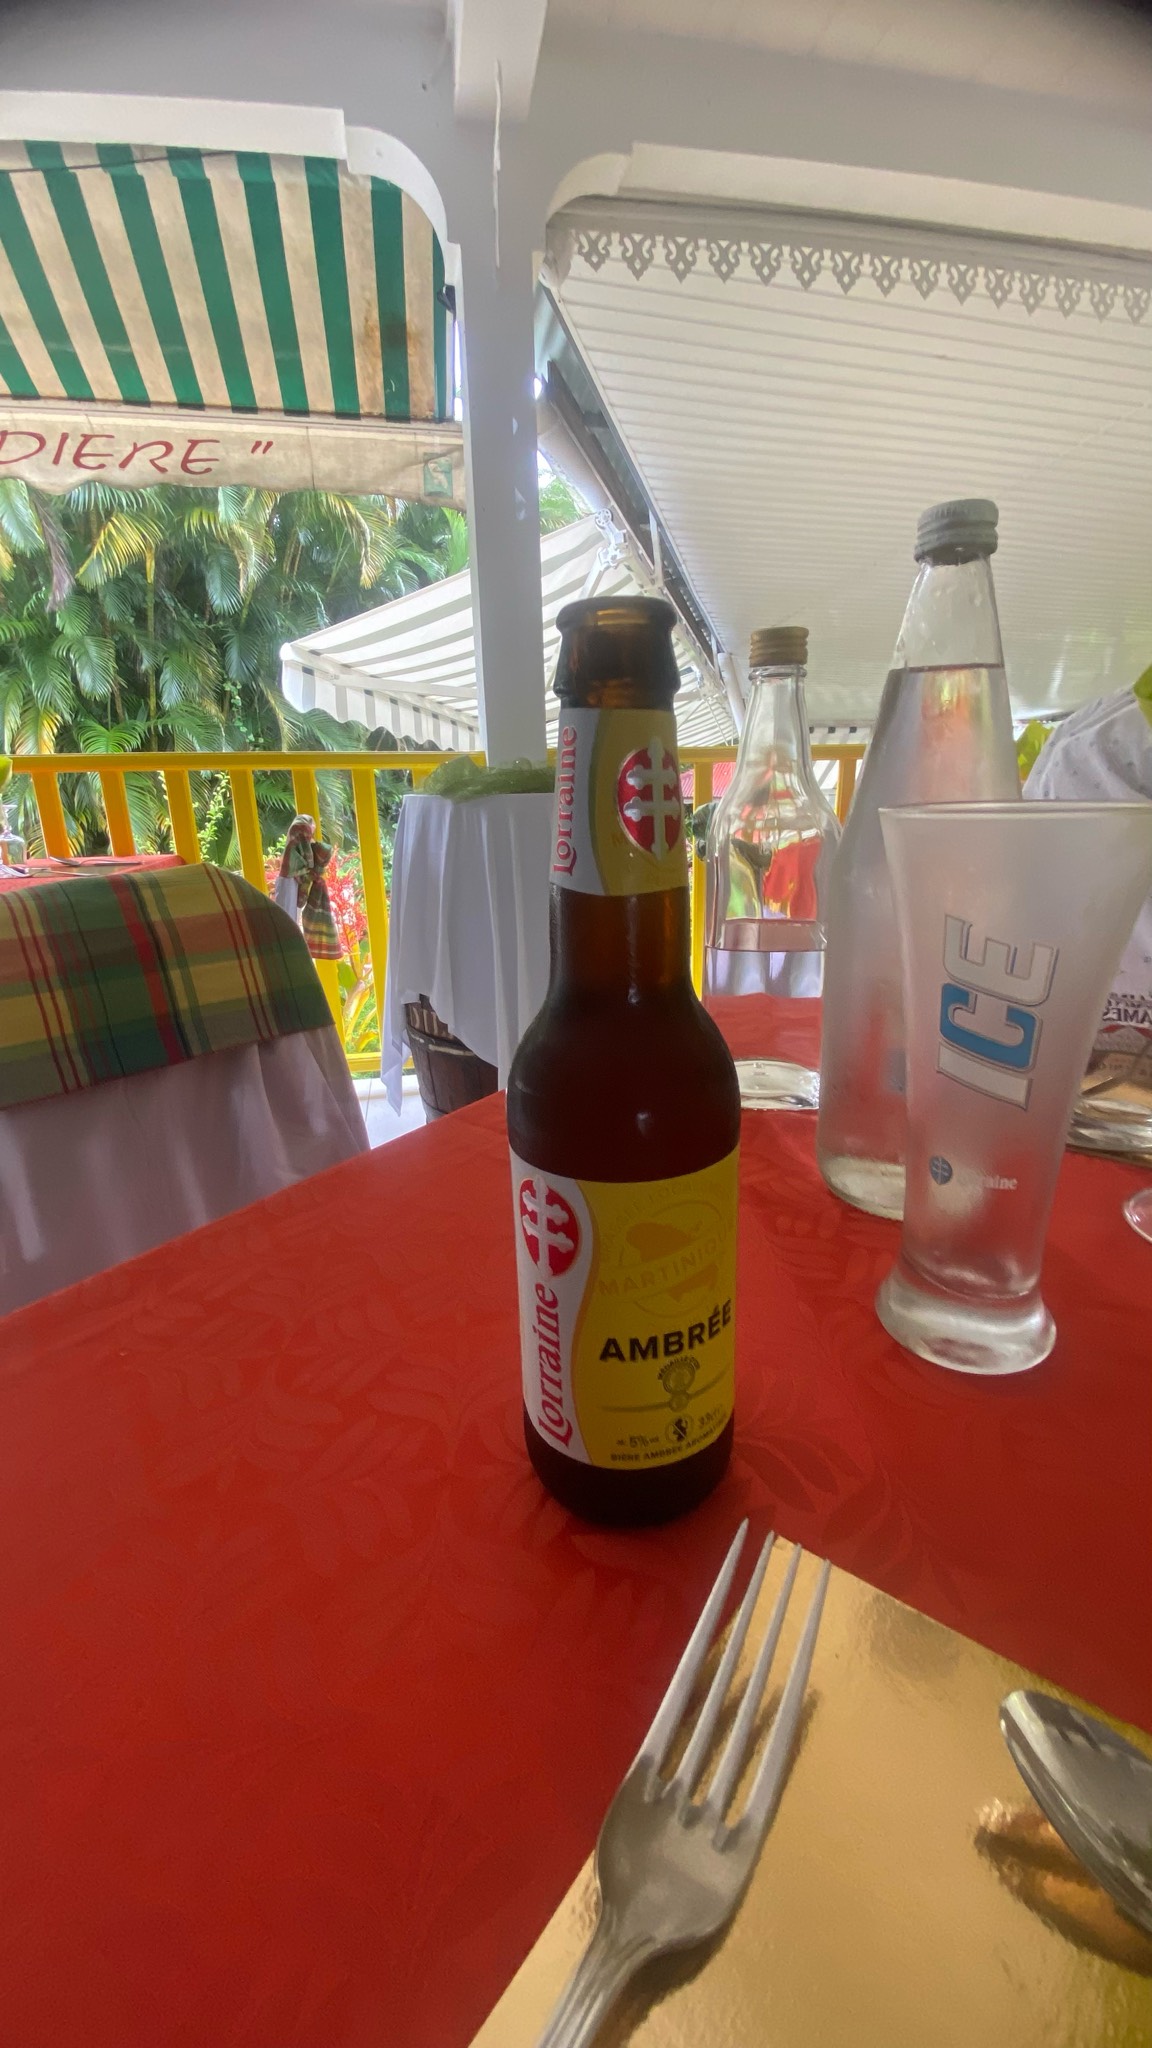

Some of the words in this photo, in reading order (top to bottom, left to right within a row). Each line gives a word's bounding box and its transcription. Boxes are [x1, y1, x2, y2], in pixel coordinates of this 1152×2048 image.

[553, 725, 578, 877] Lorraine
[936, 914, 1060, 1112] ICE
[532, 1282, 573, 1447] Lorraine
[599, 1297, 732, 1362] AMBRÉE
